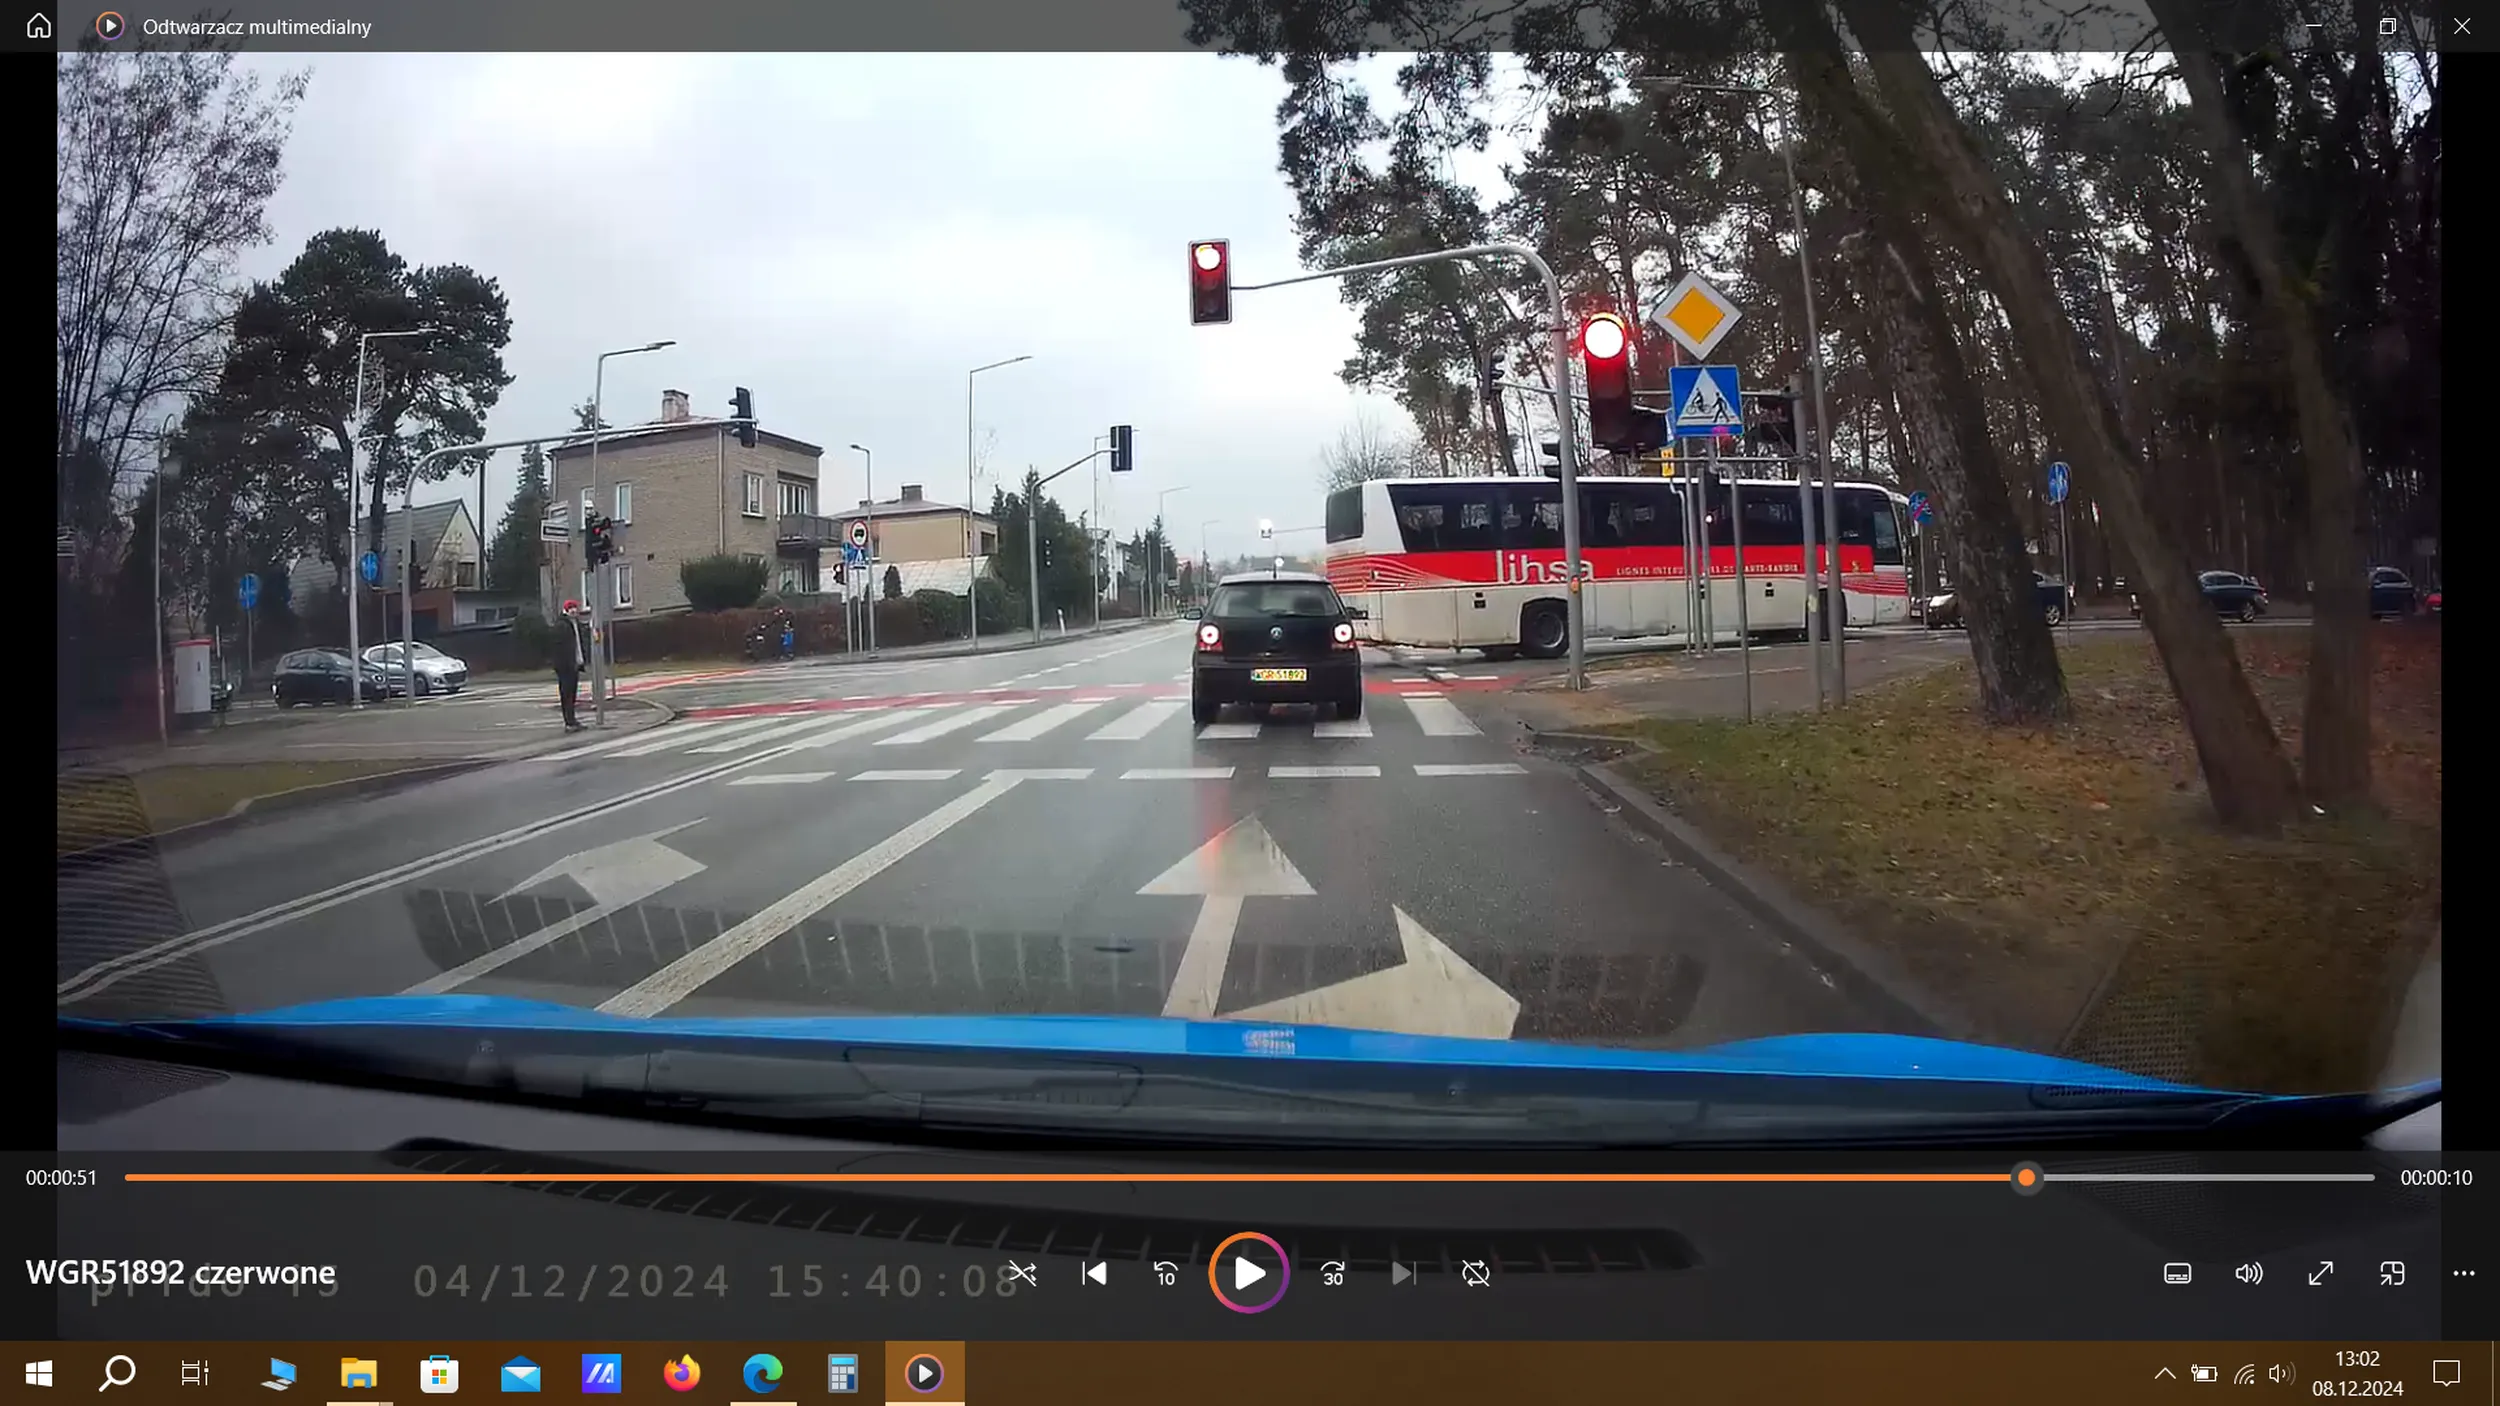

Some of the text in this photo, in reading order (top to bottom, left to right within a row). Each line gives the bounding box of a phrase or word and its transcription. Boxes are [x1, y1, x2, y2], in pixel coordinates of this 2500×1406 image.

[143, 18, 372, 39] Odtwarzacz multimedialny
[1496, 549, 1594, 583] lihsa
[26, 1169, 95, 1186] 00:00:51
[2401, 1169, 2473, 1186] 00:00:10
[25, 1259, 336, 1285] WGR51892 czerwone
[1158, 1272, 1177, 1286] 10
[1324, 1272, 1344, 1286] 30
[2335, 1350, 2380, 1367] 13:02
[2312, 1380, 2404, 1397] 08.12.2024
